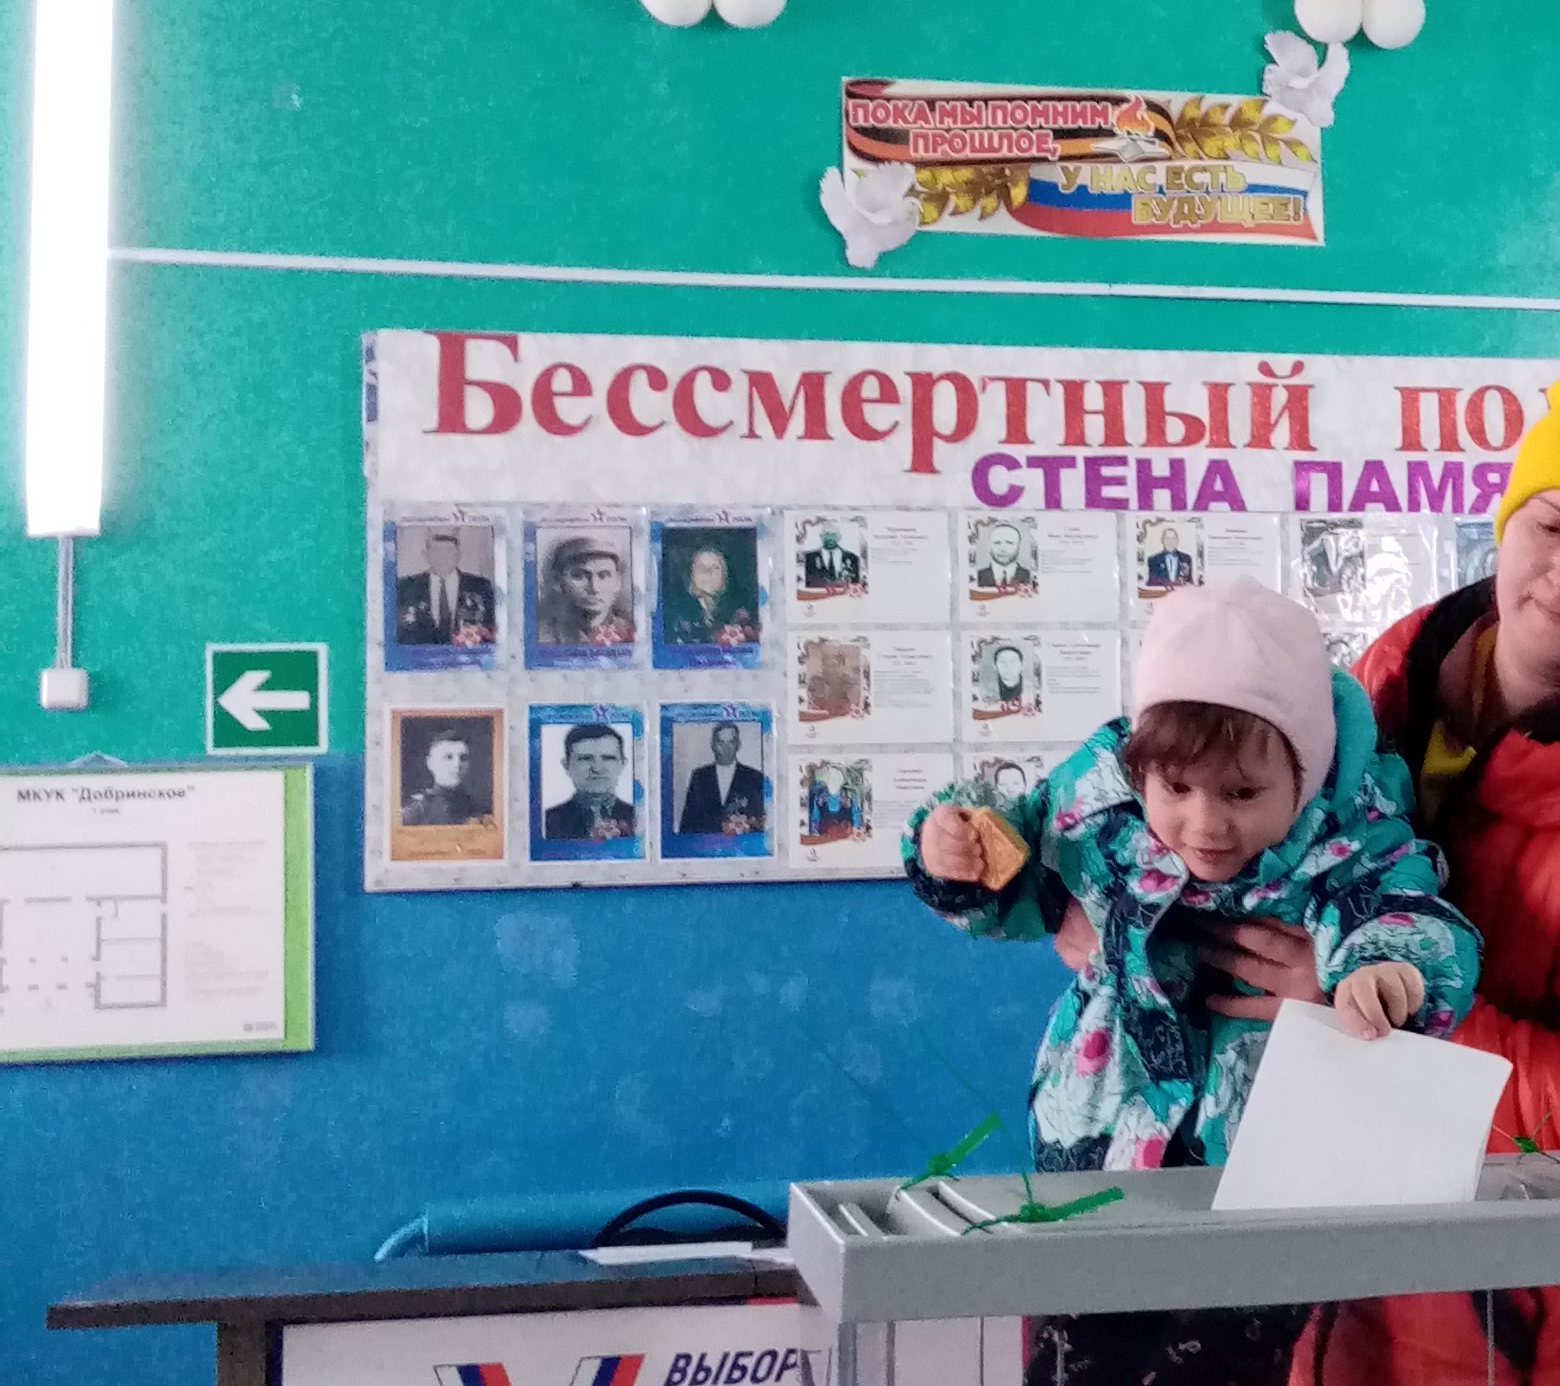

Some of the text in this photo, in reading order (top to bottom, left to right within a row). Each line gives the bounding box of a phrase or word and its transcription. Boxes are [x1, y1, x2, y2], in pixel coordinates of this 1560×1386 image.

[849, 97, 1110, 131] ПОКА МЫ ПОМНИМ
[911, 129, 1060, 160] ПРОШЛОЕ,
[1061, 162, 1245, 194] У НАС ЕСТЬ
[1132, 196, 1305, 227] БУДУЩЕЕ!
[423, 331, 1550, 475] Бессмертный по
[970, 451, 1513, 514] СТЕНА ПАМЯ
[16, 786, 67, 803] МКУК
